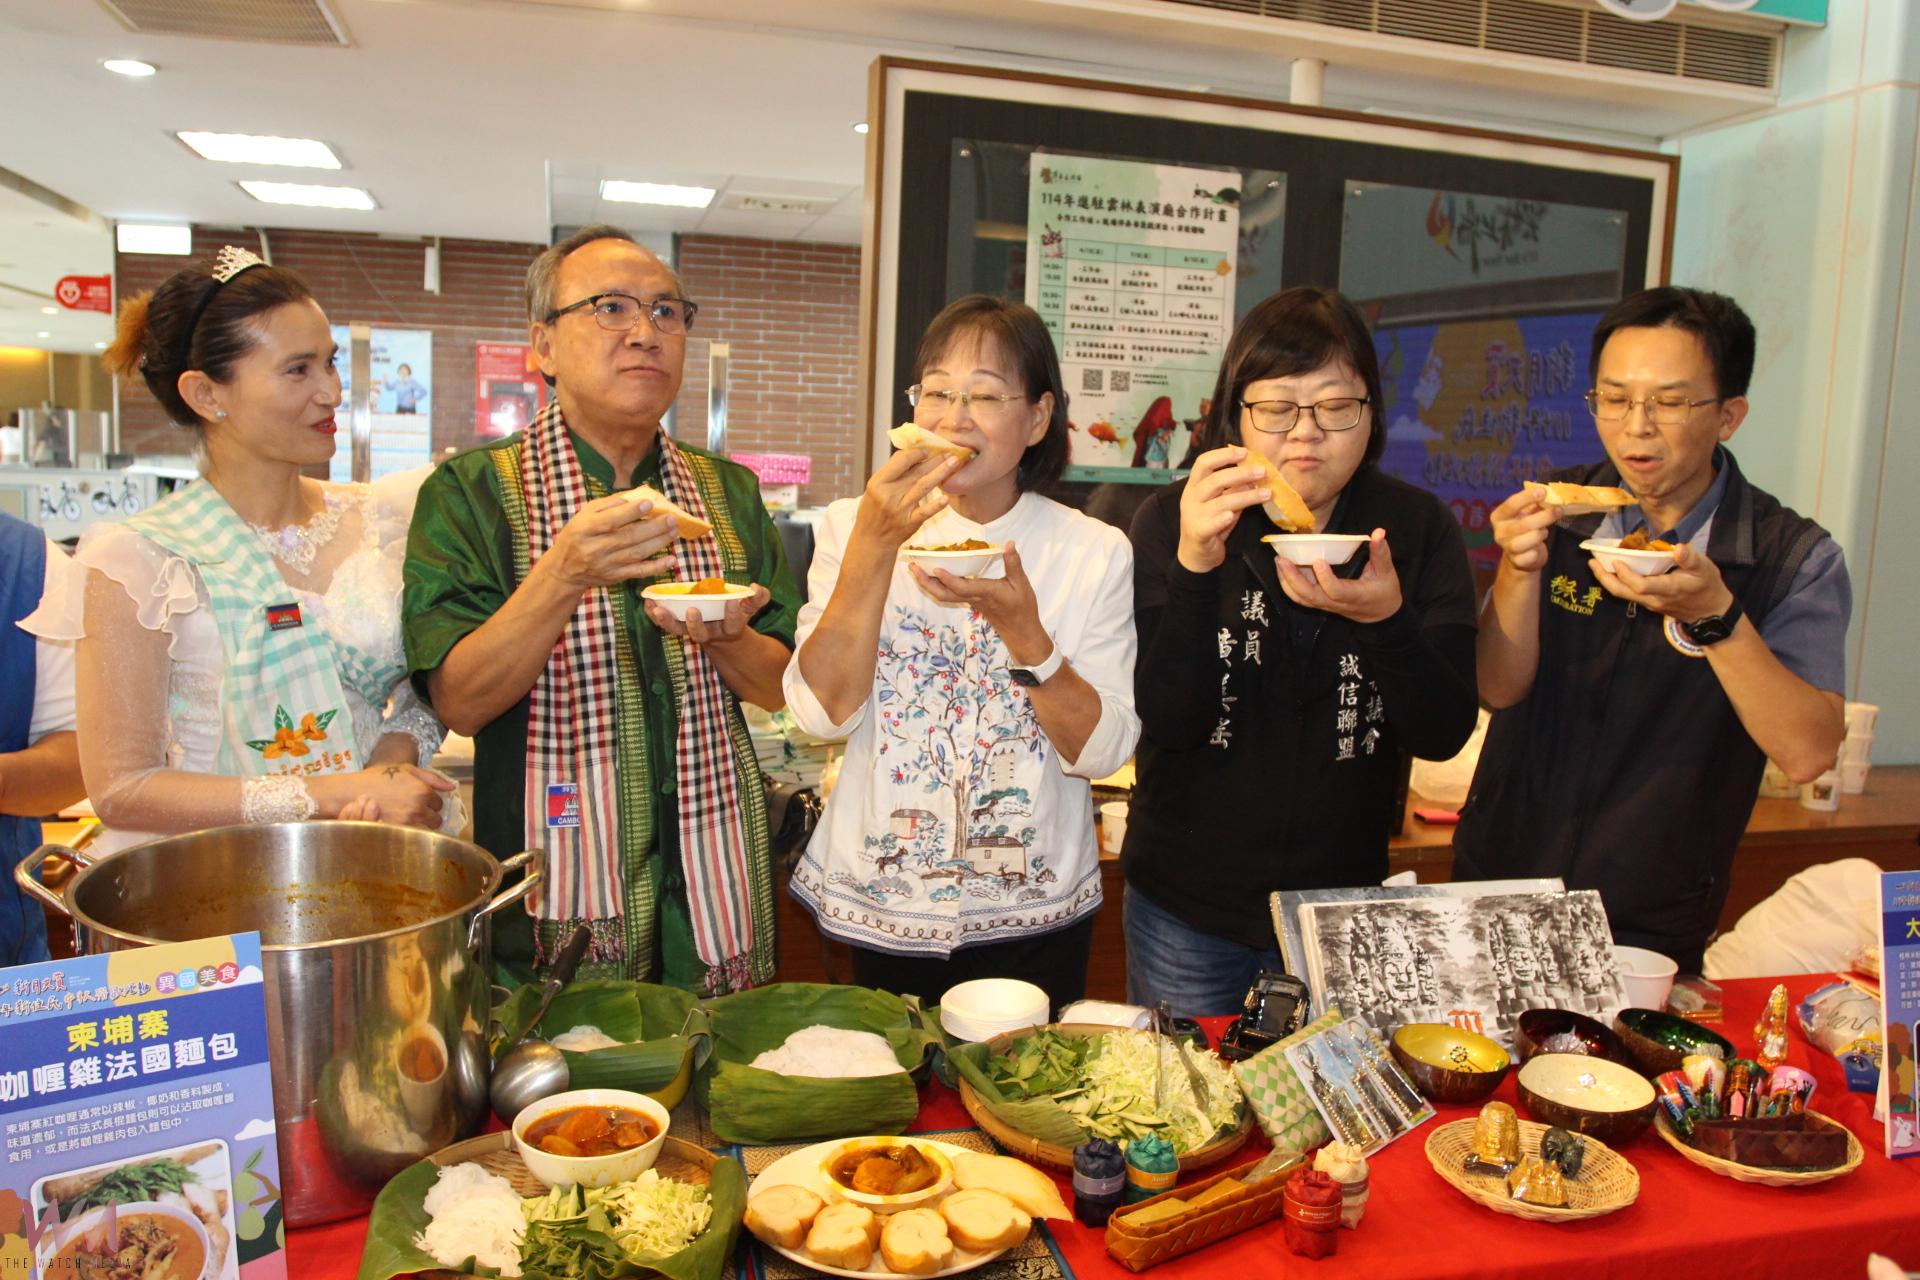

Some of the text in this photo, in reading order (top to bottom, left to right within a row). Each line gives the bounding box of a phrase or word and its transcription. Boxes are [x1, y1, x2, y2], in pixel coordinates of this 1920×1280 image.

[1241, 589, 1269, 666] 議員
[1336, 653, 1363, 761] 誠信聯盟
[1361, 680, 1385, 755] 議會
[159, 964, 237, 992] 異國美食
[66, 1010, 170, 1053] 柬埔寨
